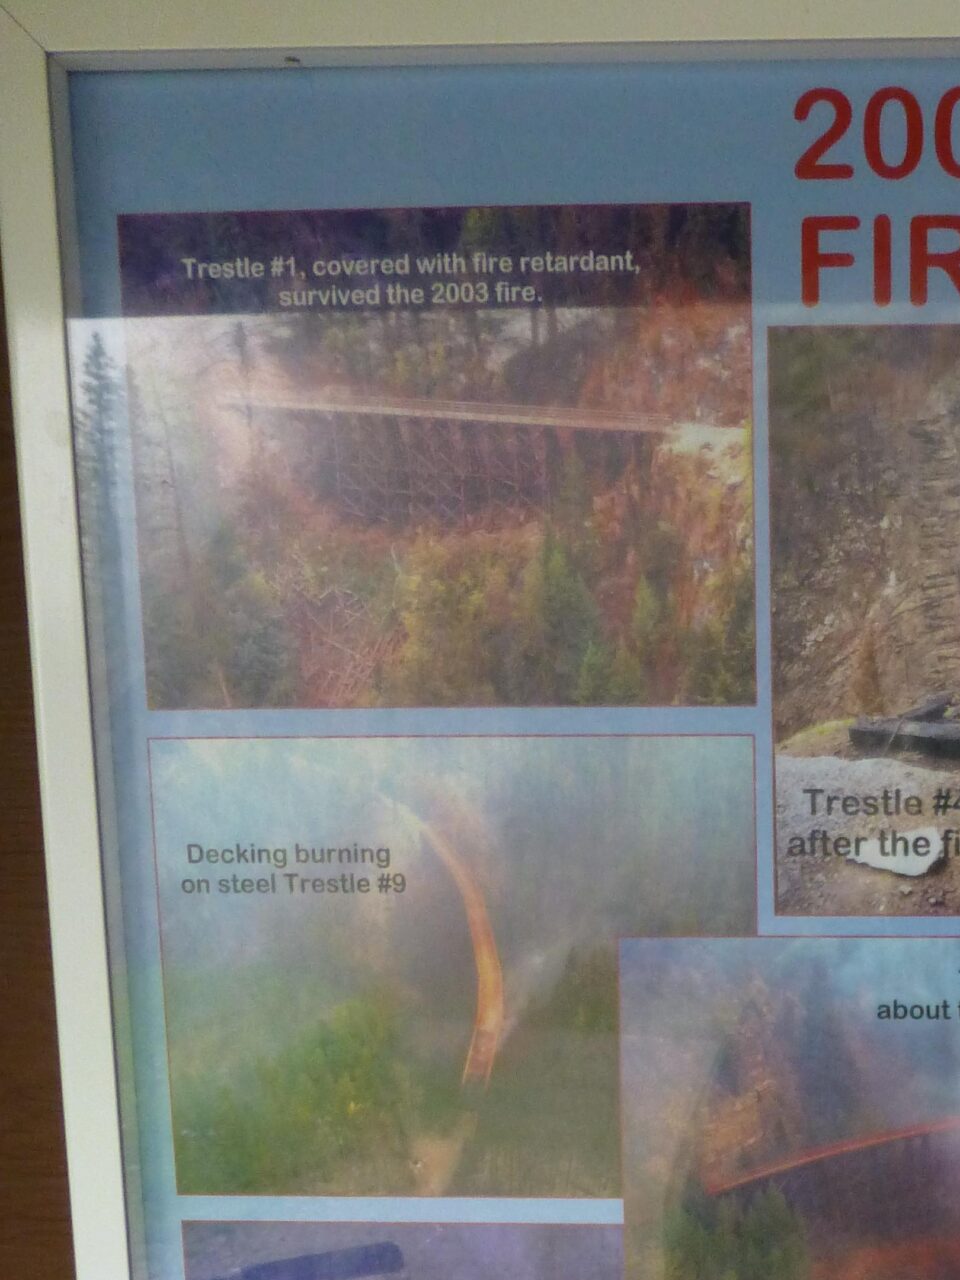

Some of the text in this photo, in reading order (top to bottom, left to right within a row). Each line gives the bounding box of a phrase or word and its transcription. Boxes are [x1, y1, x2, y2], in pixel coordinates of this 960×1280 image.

[180, 249, 641, 281] Trestle #1, covered with fire retardant,
[278, 281, 543, 307] survived the 2003 fire.
[803, 788, 923, 816] Trestle
[186, 842, 391, 869] Decking burning
[787, 829, 868, 857] after
[878, 829, 931, 858] the
[181, 872, 407, 895] on steel Trestle #9
[876, 999, 951, 1021] about
